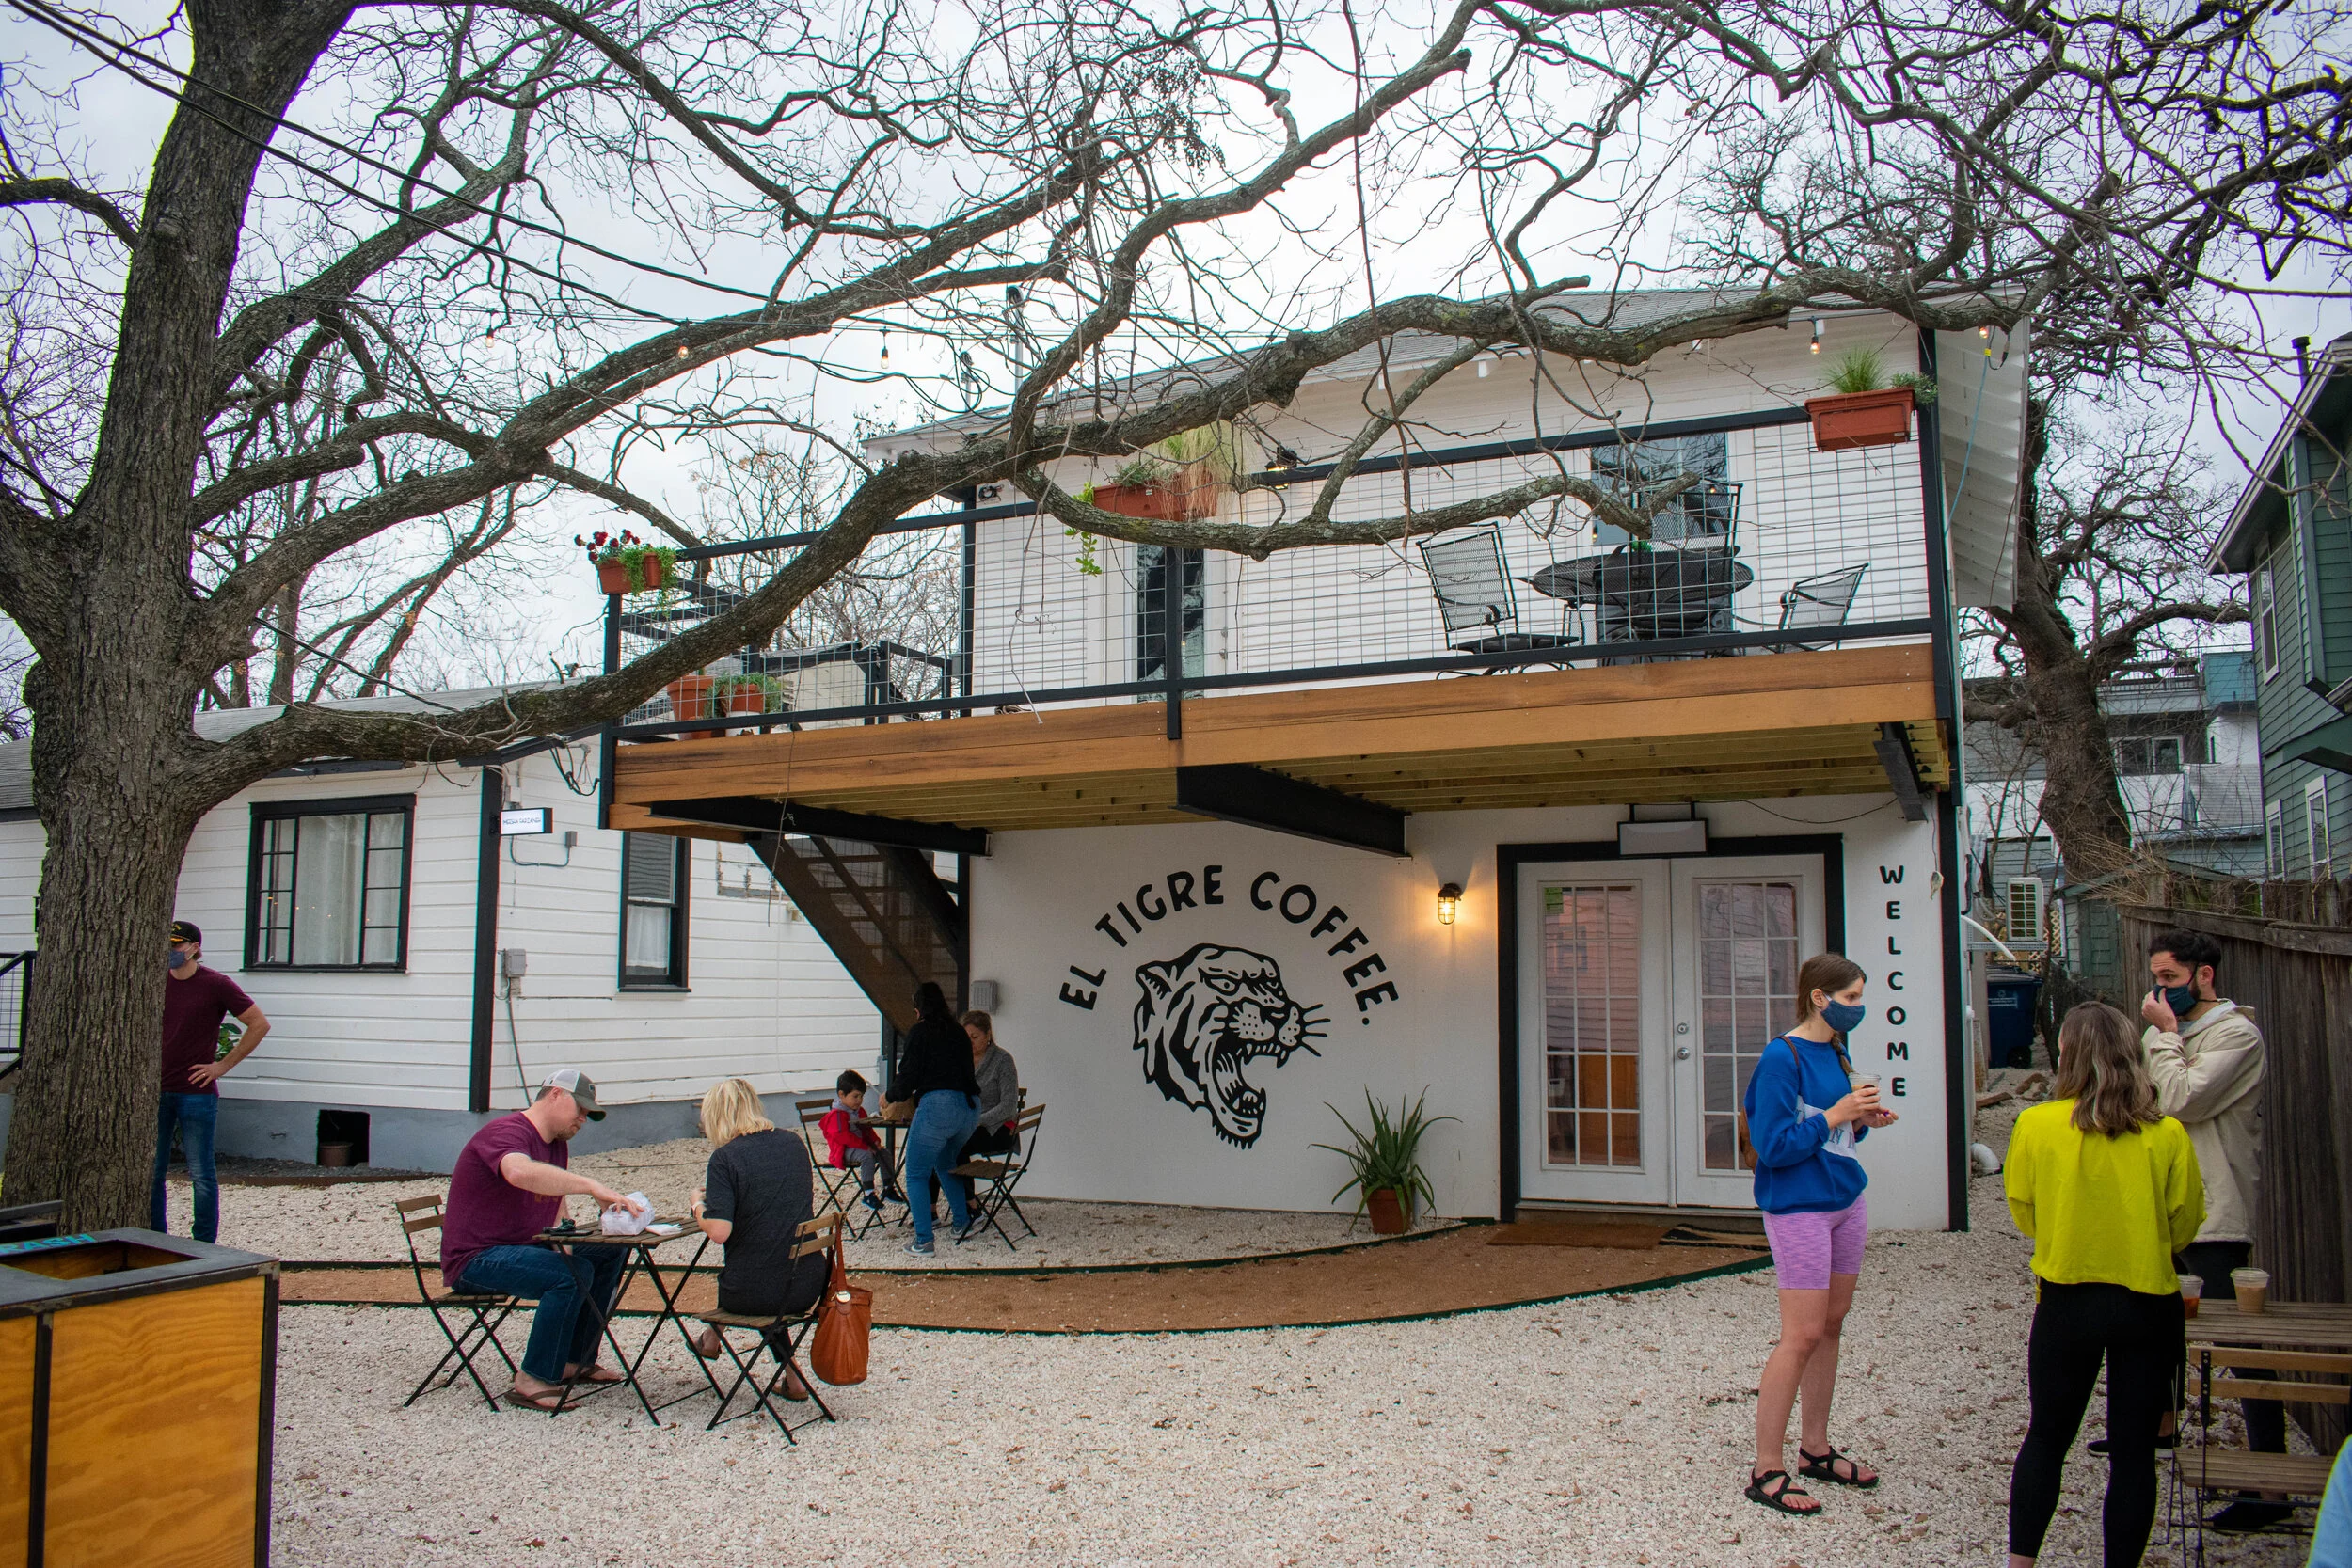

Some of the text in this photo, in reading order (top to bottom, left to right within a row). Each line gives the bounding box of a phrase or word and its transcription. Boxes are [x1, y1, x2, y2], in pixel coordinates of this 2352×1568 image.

[1059, 864, 1400, 1026] EL TIGRE COFFEE.
[1879, 865, 1909, 1097] WELCOME
